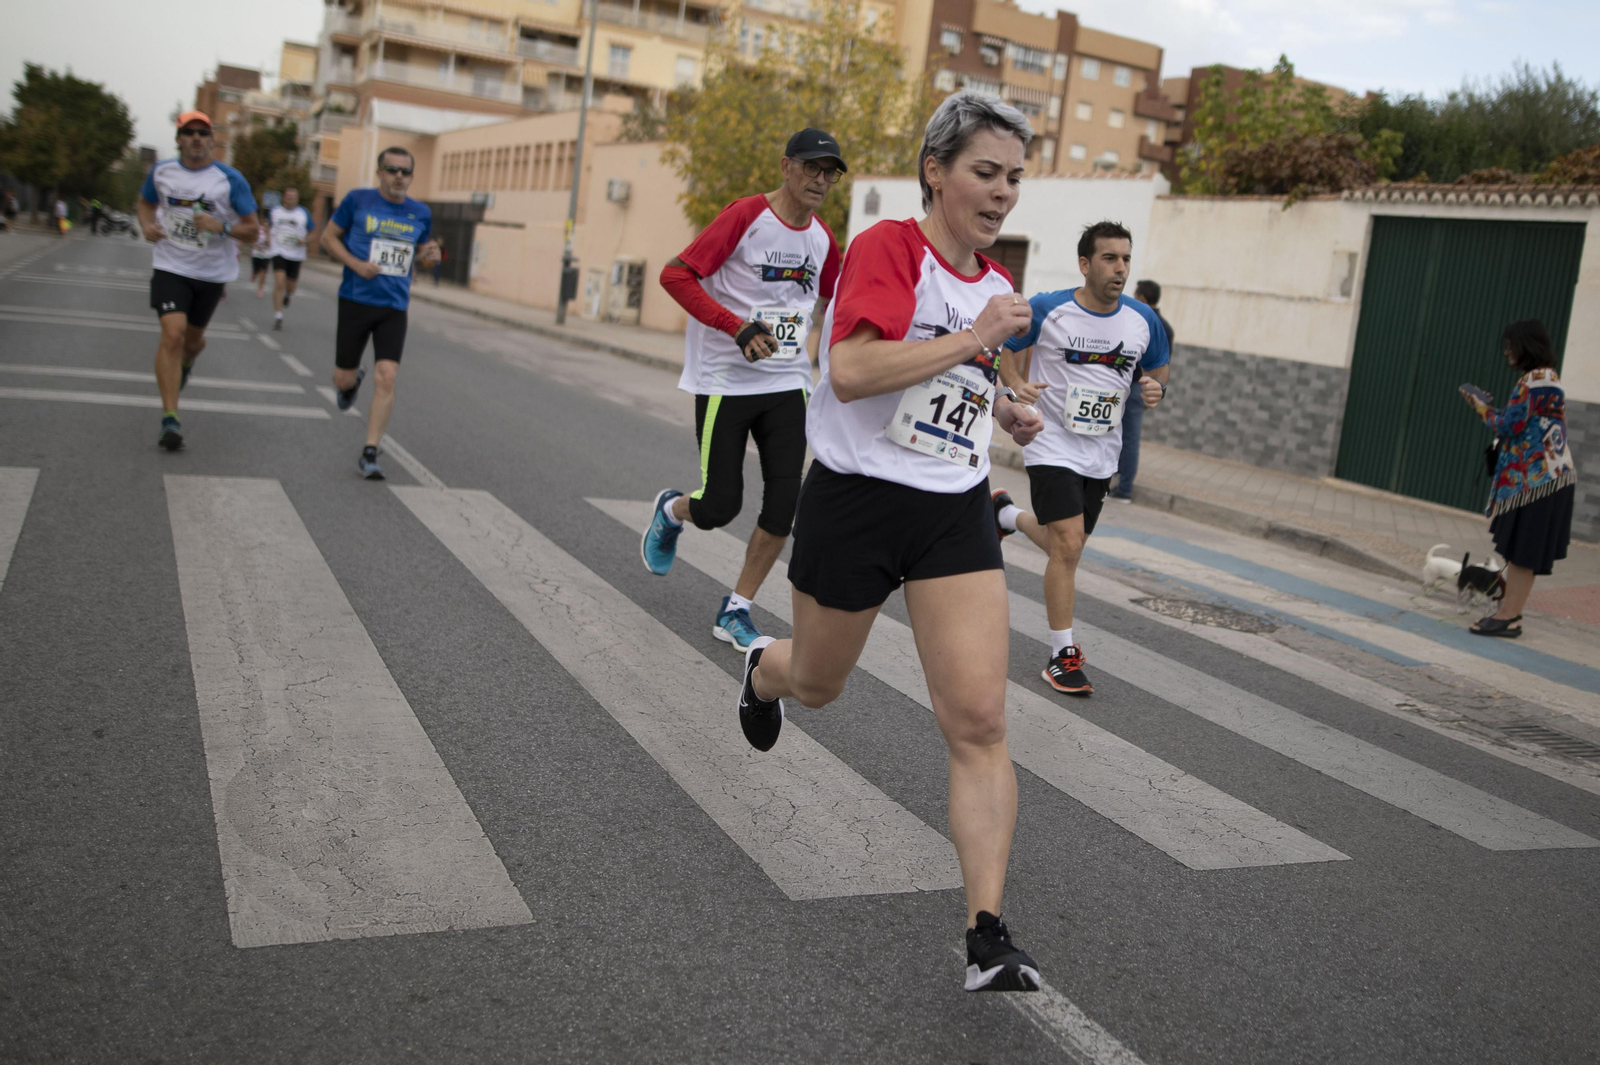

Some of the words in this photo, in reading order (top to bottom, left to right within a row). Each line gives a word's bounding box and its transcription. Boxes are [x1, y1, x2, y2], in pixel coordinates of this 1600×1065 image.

[765, 251, 781, 264] VII
[766, 268, 809, 280] ASPACE
[771, 322, 796, 340] 02
[1068, 336, 1085, 348] VII
[1069, 352, 1126, 365] ASPACE
[929, 393, 979, 436] 147
[1078, 400, 1112, 420] 560
